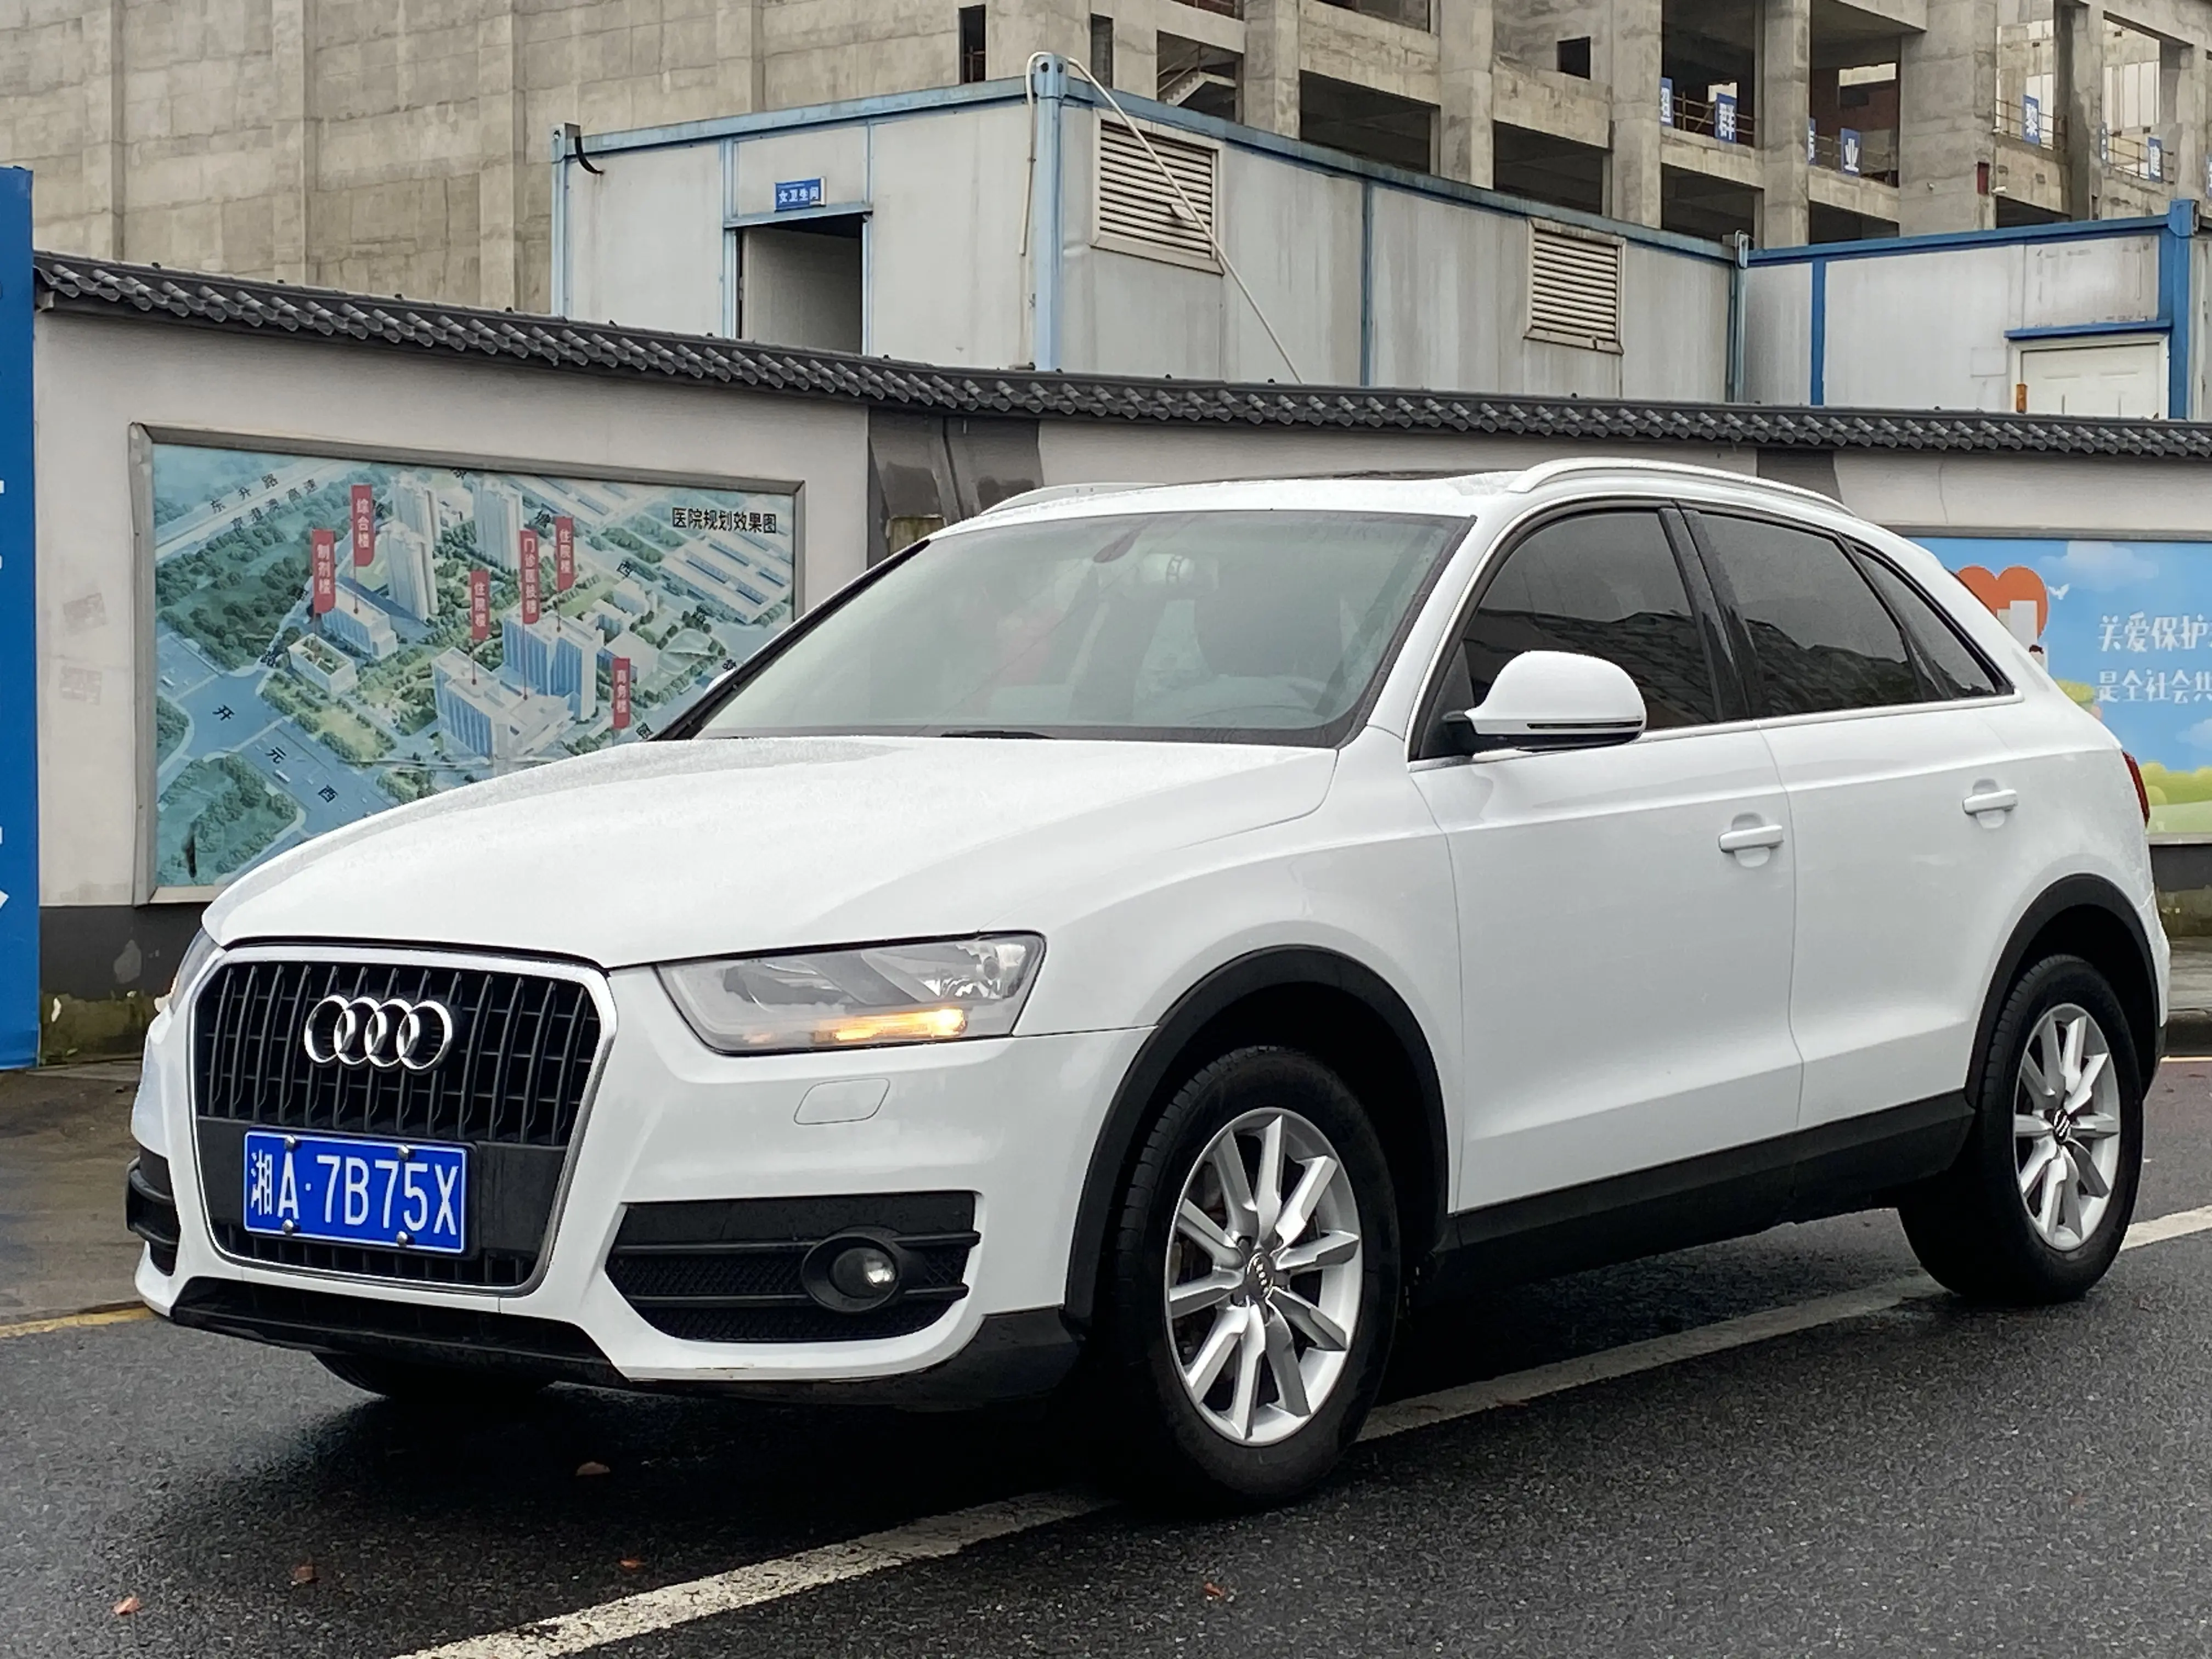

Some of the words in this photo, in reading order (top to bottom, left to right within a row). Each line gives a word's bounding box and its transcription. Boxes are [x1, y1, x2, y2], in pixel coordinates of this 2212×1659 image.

[778, 187, 819, 204] 女卫生间
[211, 473, 278, 514] 东升路
[356, 498, 370, 548] 综合楼
[672, 507, 776, 534] 医院规划效果图
[559, 529, 571, 574] 住院楼
[523, 538, 537, 614] 门诊医技楼
[474, 582, 486, 627] 住院楼
[2098, 611, 2212, 652] 关爱保护
